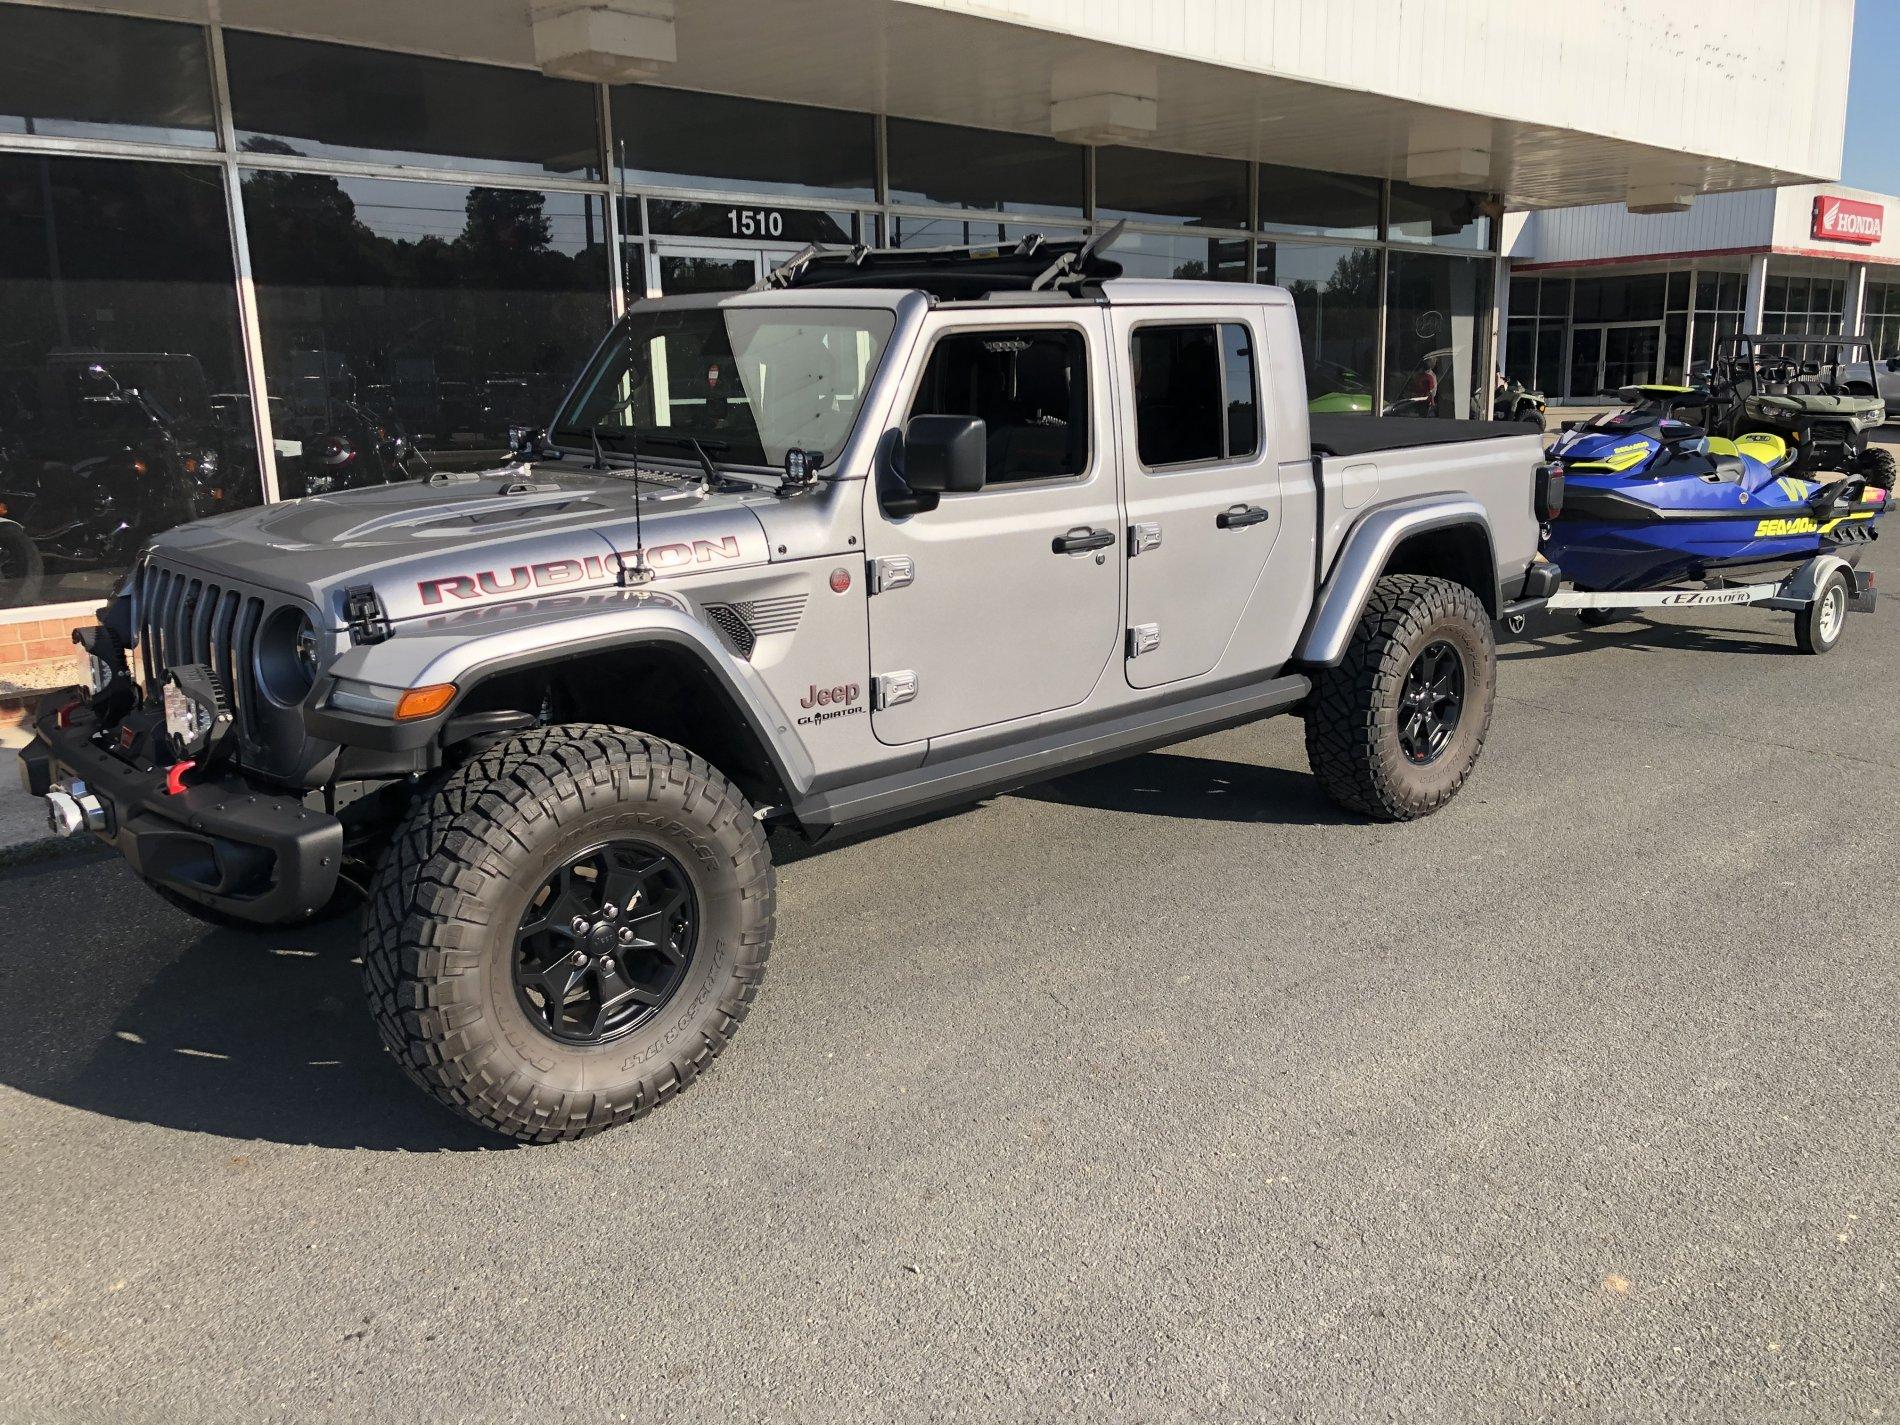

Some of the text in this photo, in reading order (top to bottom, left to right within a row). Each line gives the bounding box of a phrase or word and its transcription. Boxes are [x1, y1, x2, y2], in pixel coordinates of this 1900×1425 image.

[728, 209, 783, 236] 1510
[1837, 213, 1882, 235] HONDA
[417, 536, 741, 606] RUBICON
[800, 683, 860, 709] Jeep
